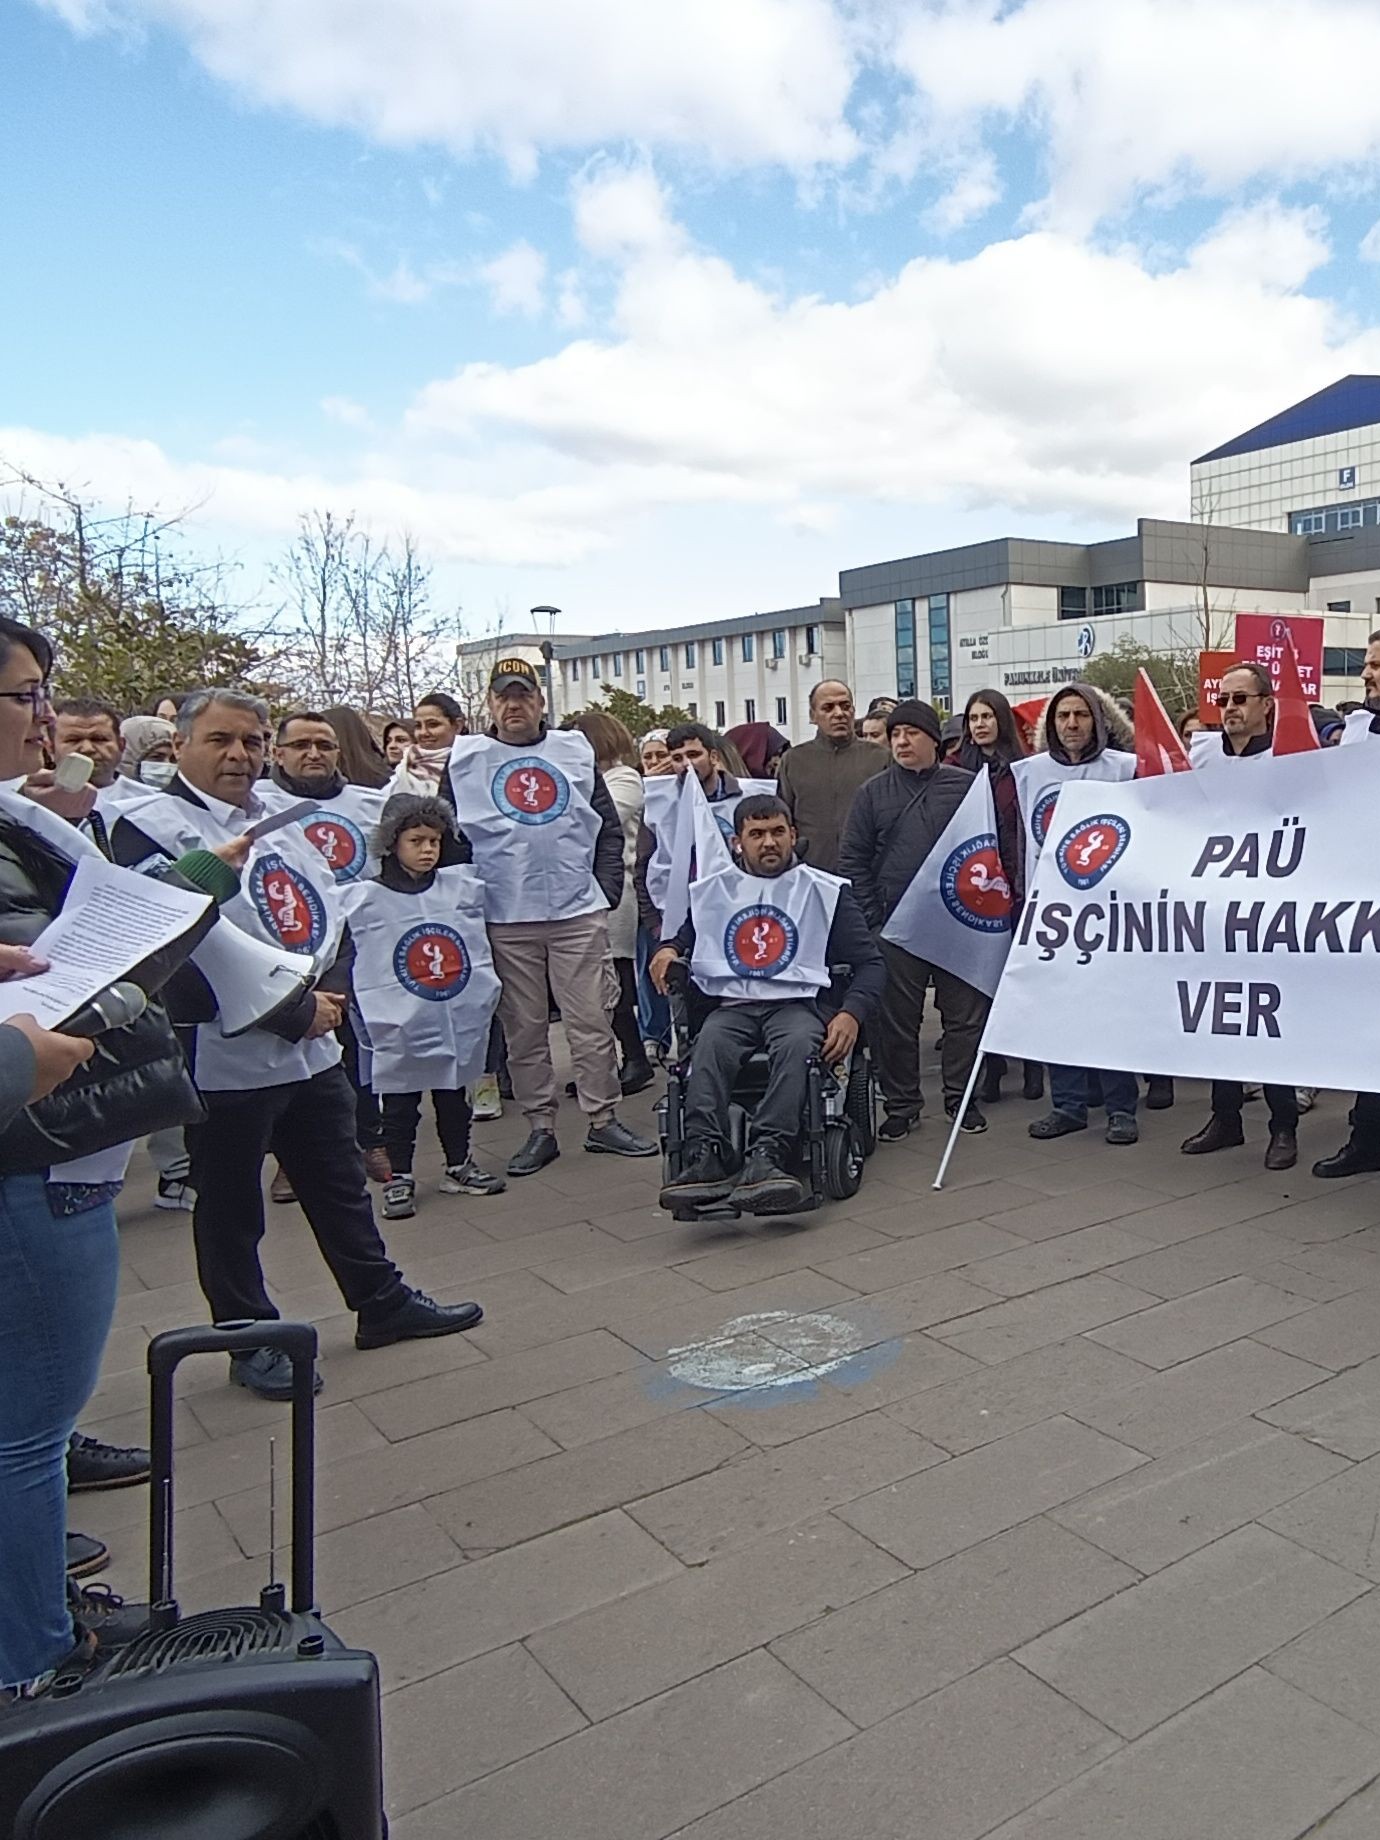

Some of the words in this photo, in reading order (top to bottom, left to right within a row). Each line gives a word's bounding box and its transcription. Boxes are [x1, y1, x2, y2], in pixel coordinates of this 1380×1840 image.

[1343, 469, 1351, 482] F
[498, 660, 530, 675] ICON
[1190, 817, 1306, 877] PAÜ
[1018, 889, 1206, 965] İŞÇİNİN
[1177, 981, 1281, 1038] VER
